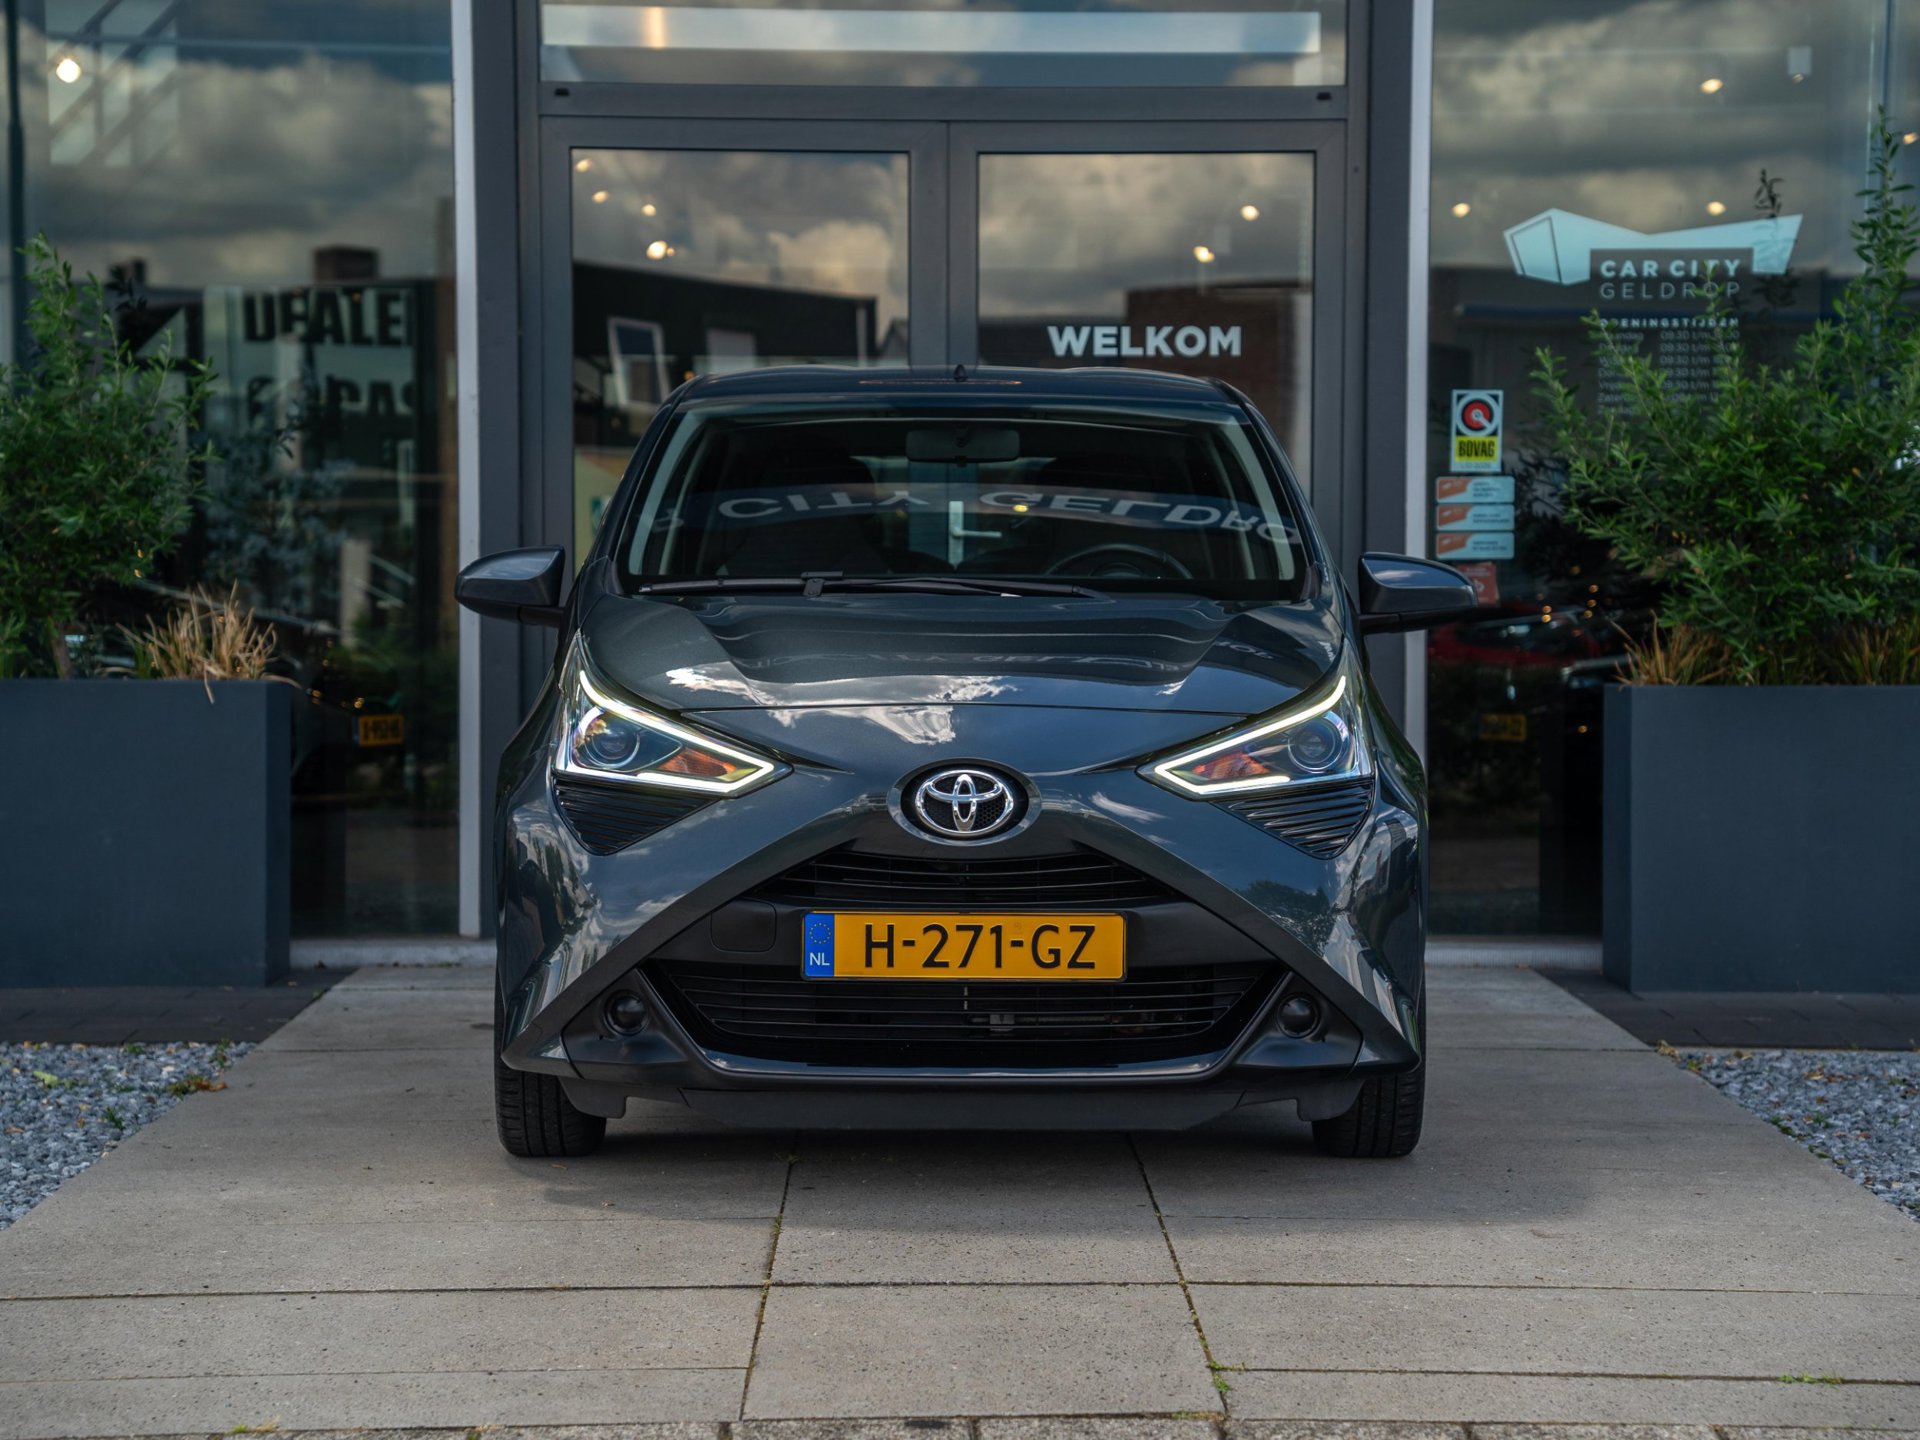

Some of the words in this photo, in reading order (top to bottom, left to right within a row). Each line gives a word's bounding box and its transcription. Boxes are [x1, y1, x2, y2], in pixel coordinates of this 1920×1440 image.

[1600, 259, 1659, 278] CAR
[1669, 259, 1741, 278] CITY
[1600, 282, 1740, 300] GELDROP
[1047, 325, 1242, 357] WELKOM
[1458, 440, 1495, 458] BOVAG
[865, 923, 1096, 970] H-271-GZ
[809, 953, 830, 966] NL
